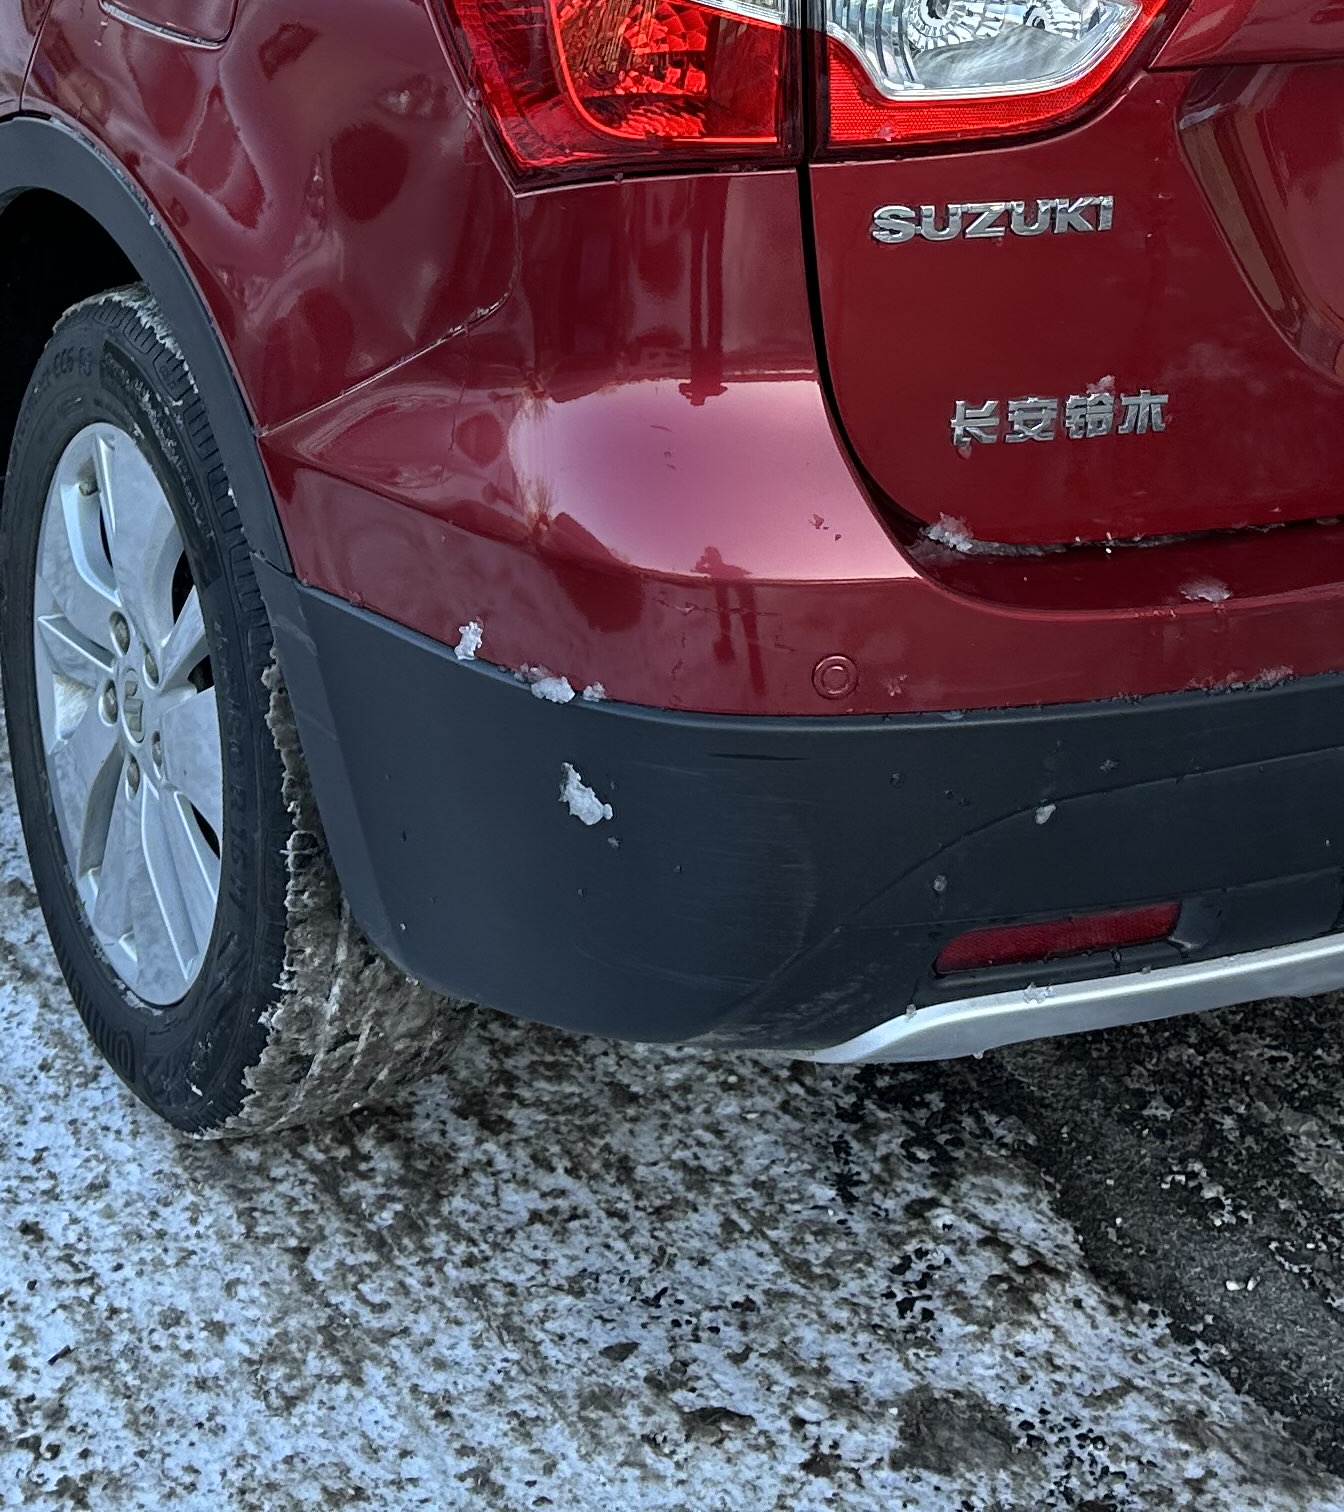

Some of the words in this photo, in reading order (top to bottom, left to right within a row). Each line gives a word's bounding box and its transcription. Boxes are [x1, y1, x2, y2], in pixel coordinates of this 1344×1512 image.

[871, 195, 1115, 244] SUZUKI
[951, 389, 1169, 448] 长安铃木
